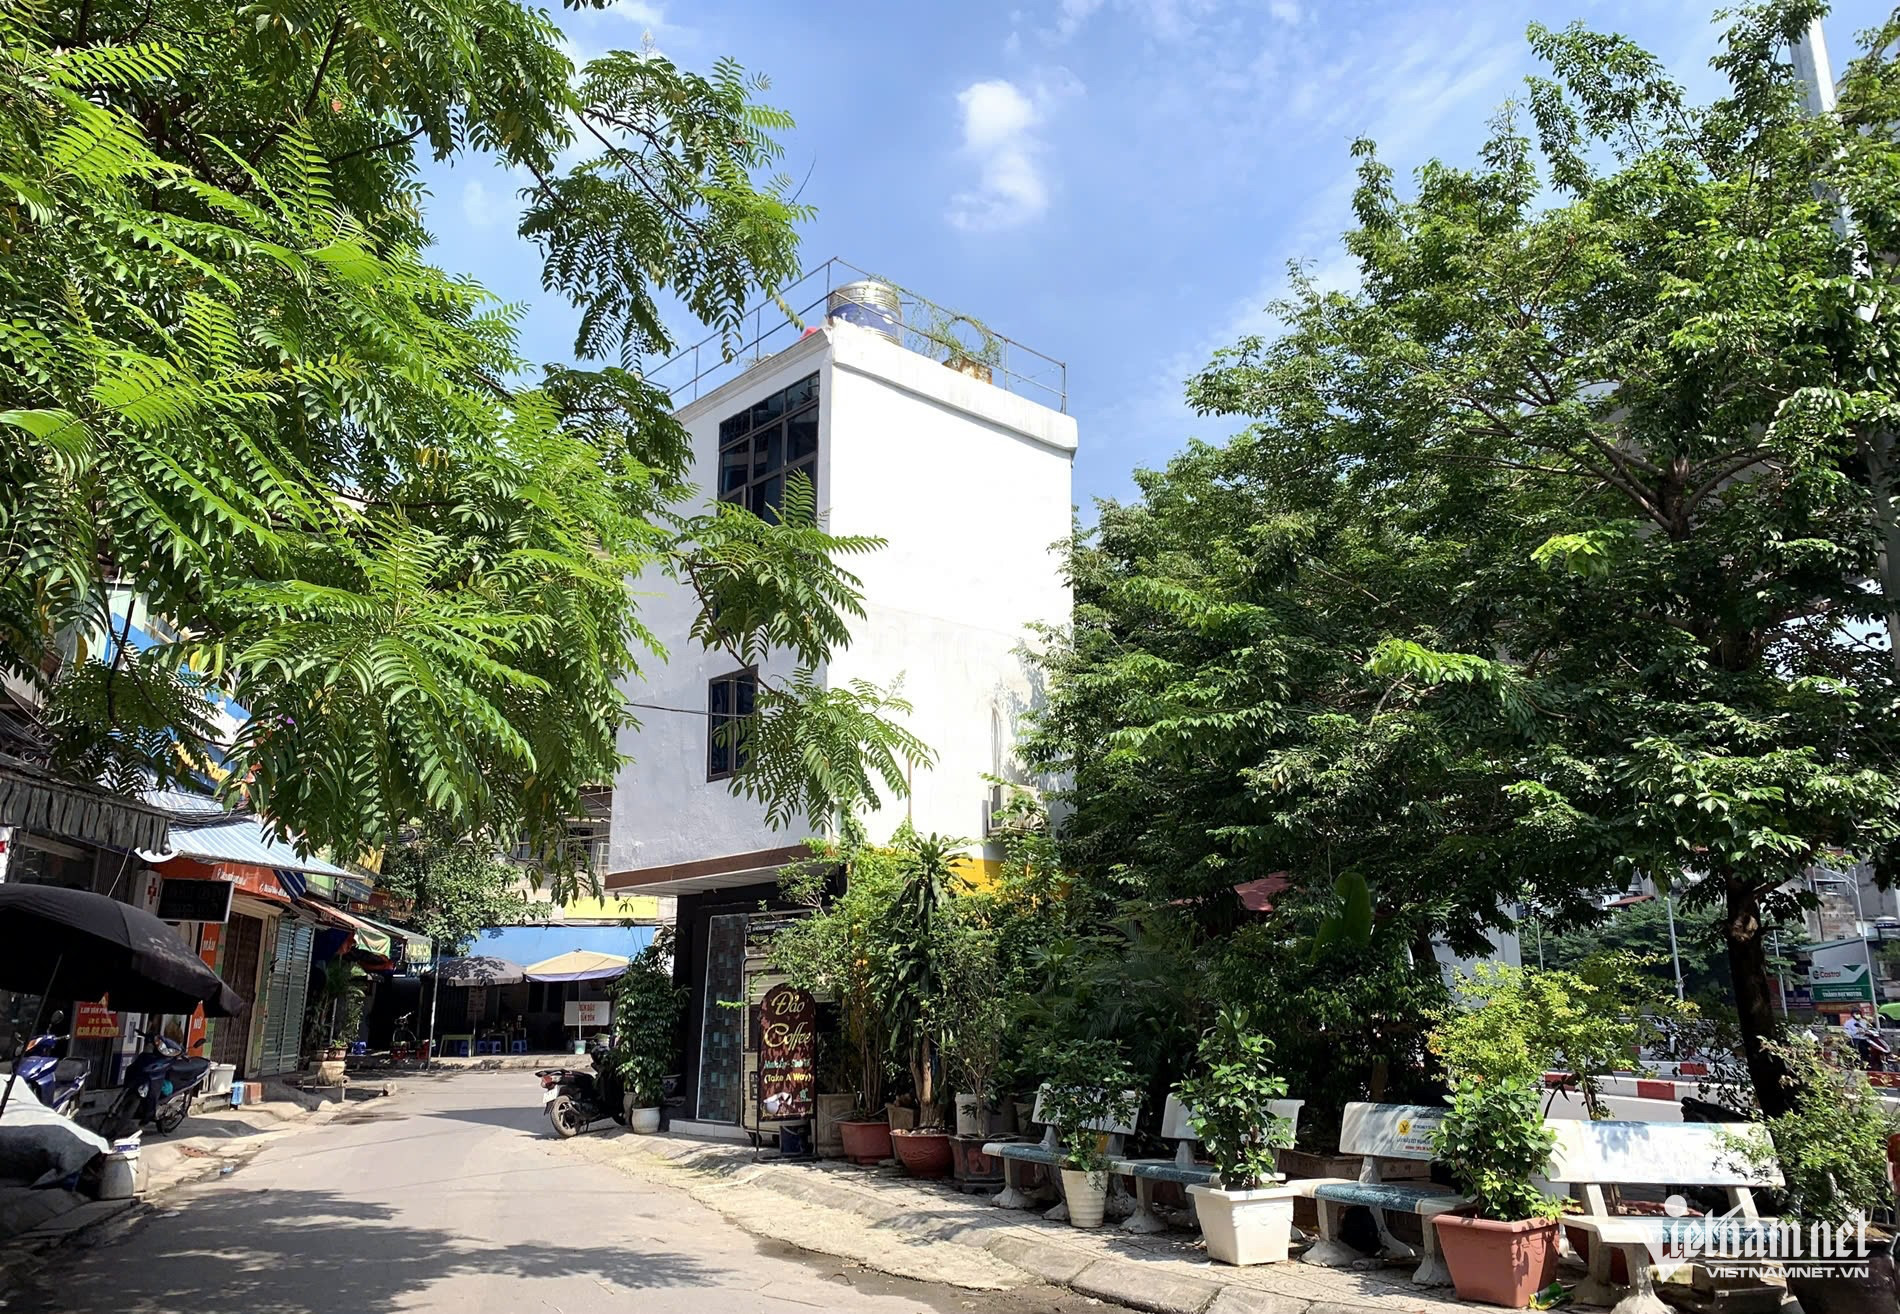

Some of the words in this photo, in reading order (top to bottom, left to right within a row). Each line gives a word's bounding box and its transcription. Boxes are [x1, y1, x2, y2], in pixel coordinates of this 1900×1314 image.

[1820, 970, 1840, 979] Castrol
[764, 1022, 811, 1051] Coffee
[764, 1074, 784, 1084] (Take
[785, 1073, 792, 1081] A
[792, 1072, 812, 1082] Way)
